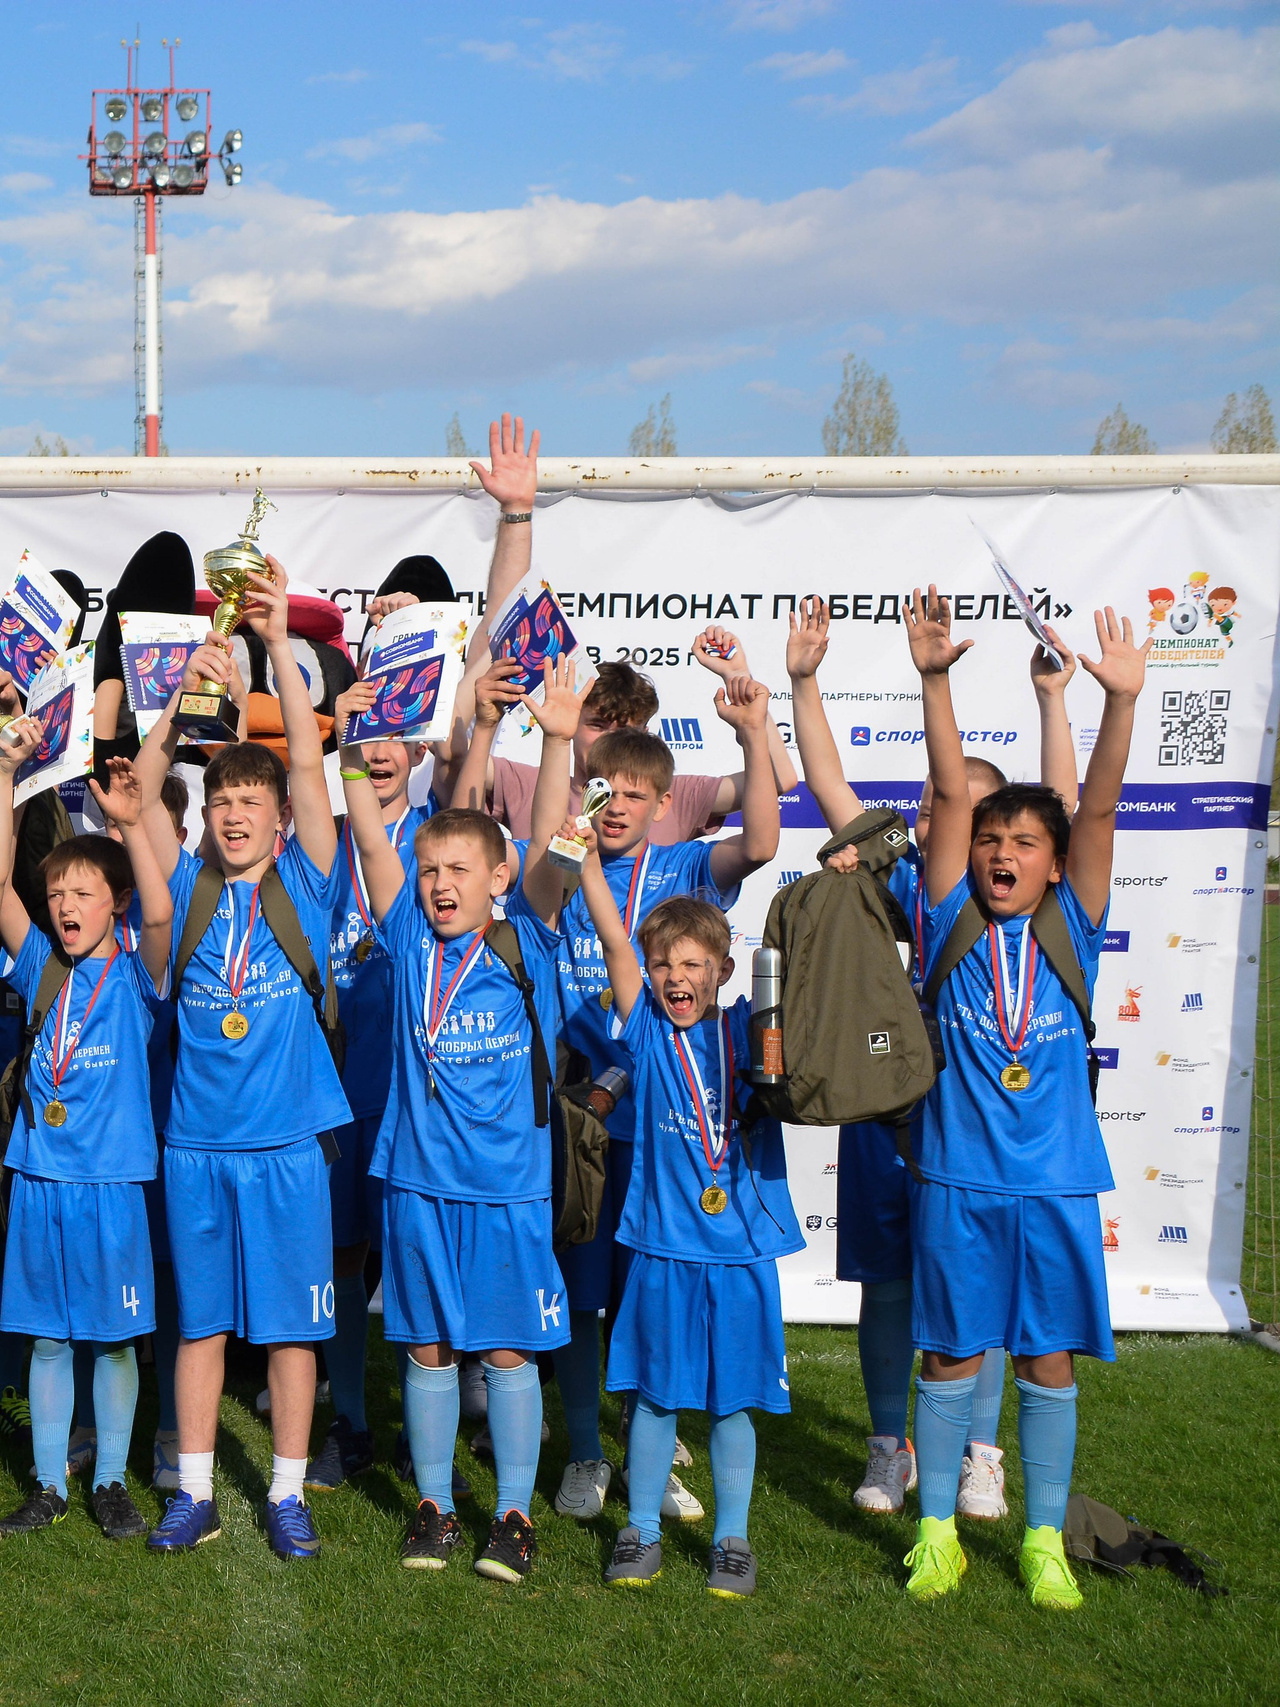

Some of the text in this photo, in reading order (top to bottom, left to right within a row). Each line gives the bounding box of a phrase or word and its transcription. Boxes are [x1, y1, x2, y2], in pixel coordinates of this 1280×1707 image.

[557, 592, 763, 619] ЕМПИОНАТ
[1152, 638, 1219, 648] ЧЕМПИОНАТ
[616, 646, 680, 666] 2025
[821, 692, 923, 701] ПАРТНЕРЫ ТУРНИ
[874, 728, 1018, 746] спорастер
[1191, 796, 1254, 805] СТРАТЕГИЧЕСКИЙ
[1114, 801, 1176, 813] КОМБАНК
[1203, 805, 1235, 813] ПАРТНЕР
[1192, 887, 1255, 896] спортмастер
[478, 1055, 494, 1064] не
[1173, 1125, 1241, 1135] спортмастер
[121, 1284, 141, 1317] 4
[309, 1280, 336, 1323] 10
